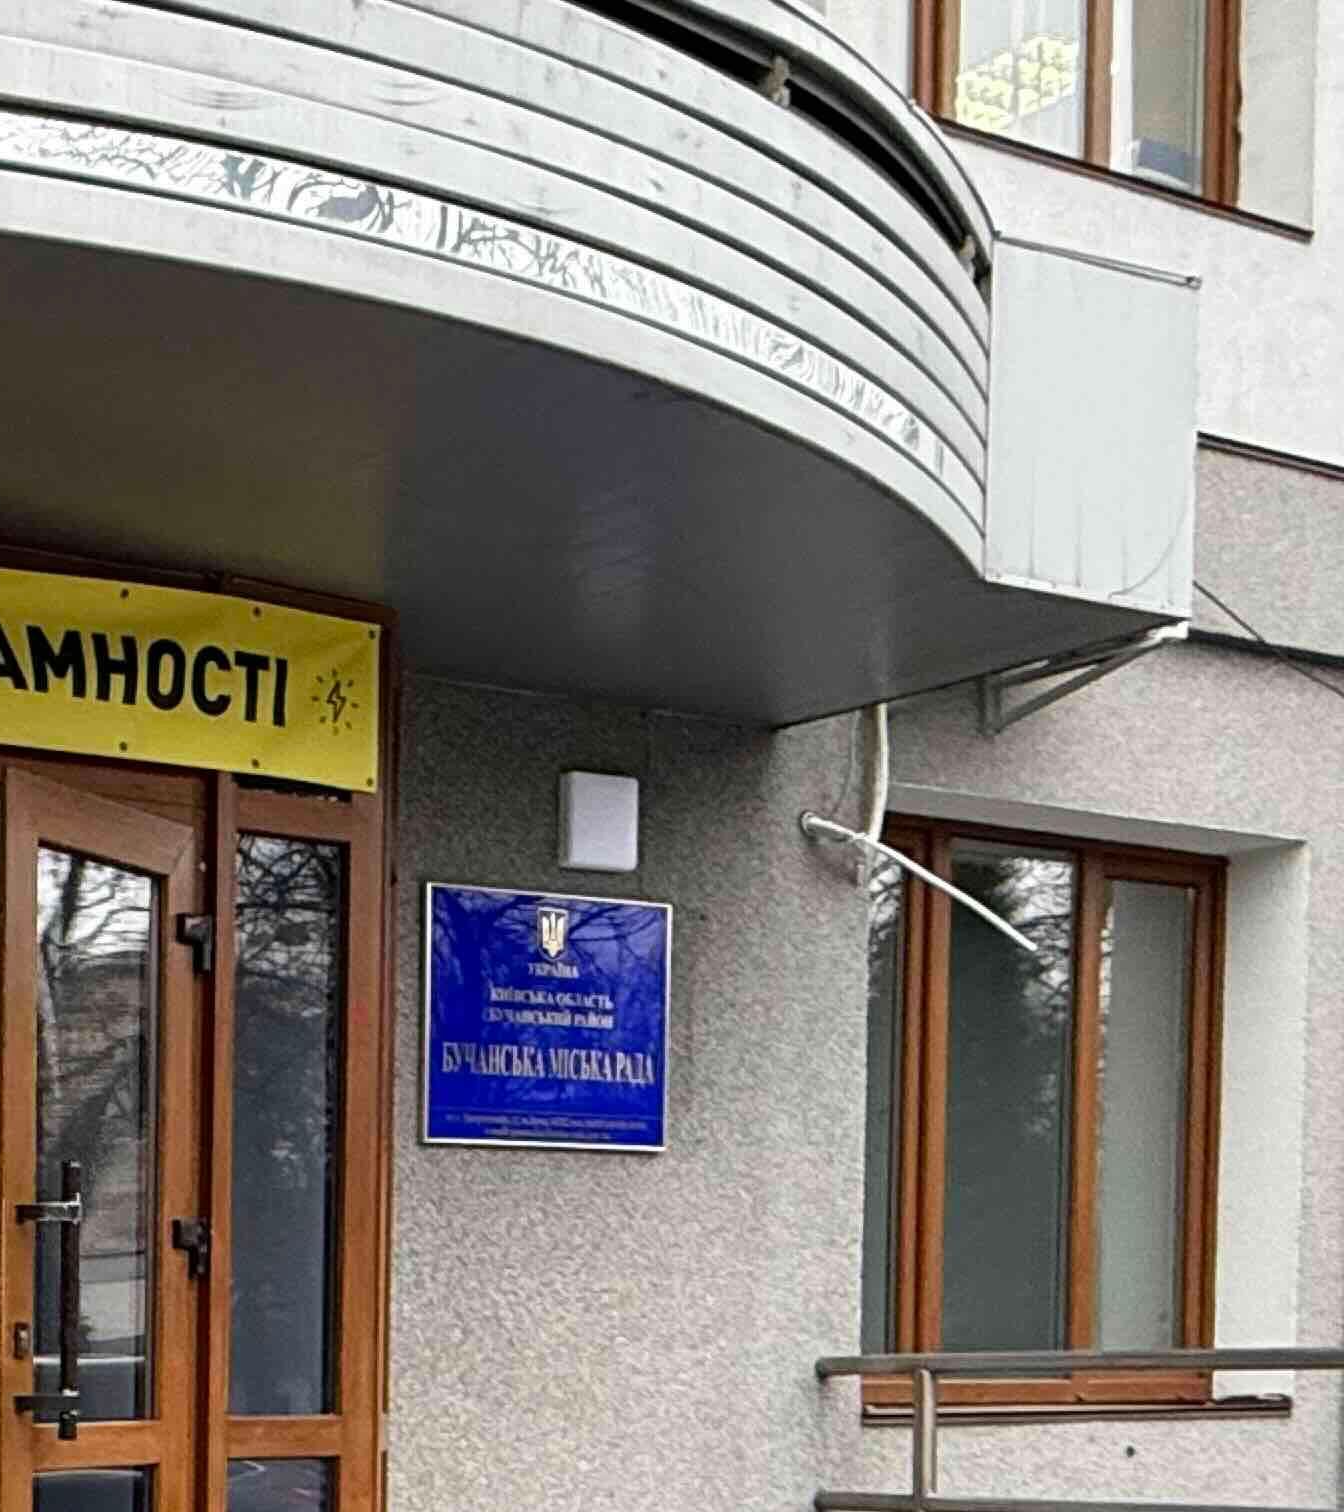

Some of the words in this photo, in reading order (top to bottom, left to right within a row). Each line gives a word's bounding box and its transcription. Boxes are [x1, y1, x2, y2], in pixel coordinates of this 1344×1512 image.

[442, 1041, 546, 1079] БУЧАНСЬКА
[548, 1048, 612, 1082] МІСЬКА
[615, 1052, 656, 1087] РАДА
